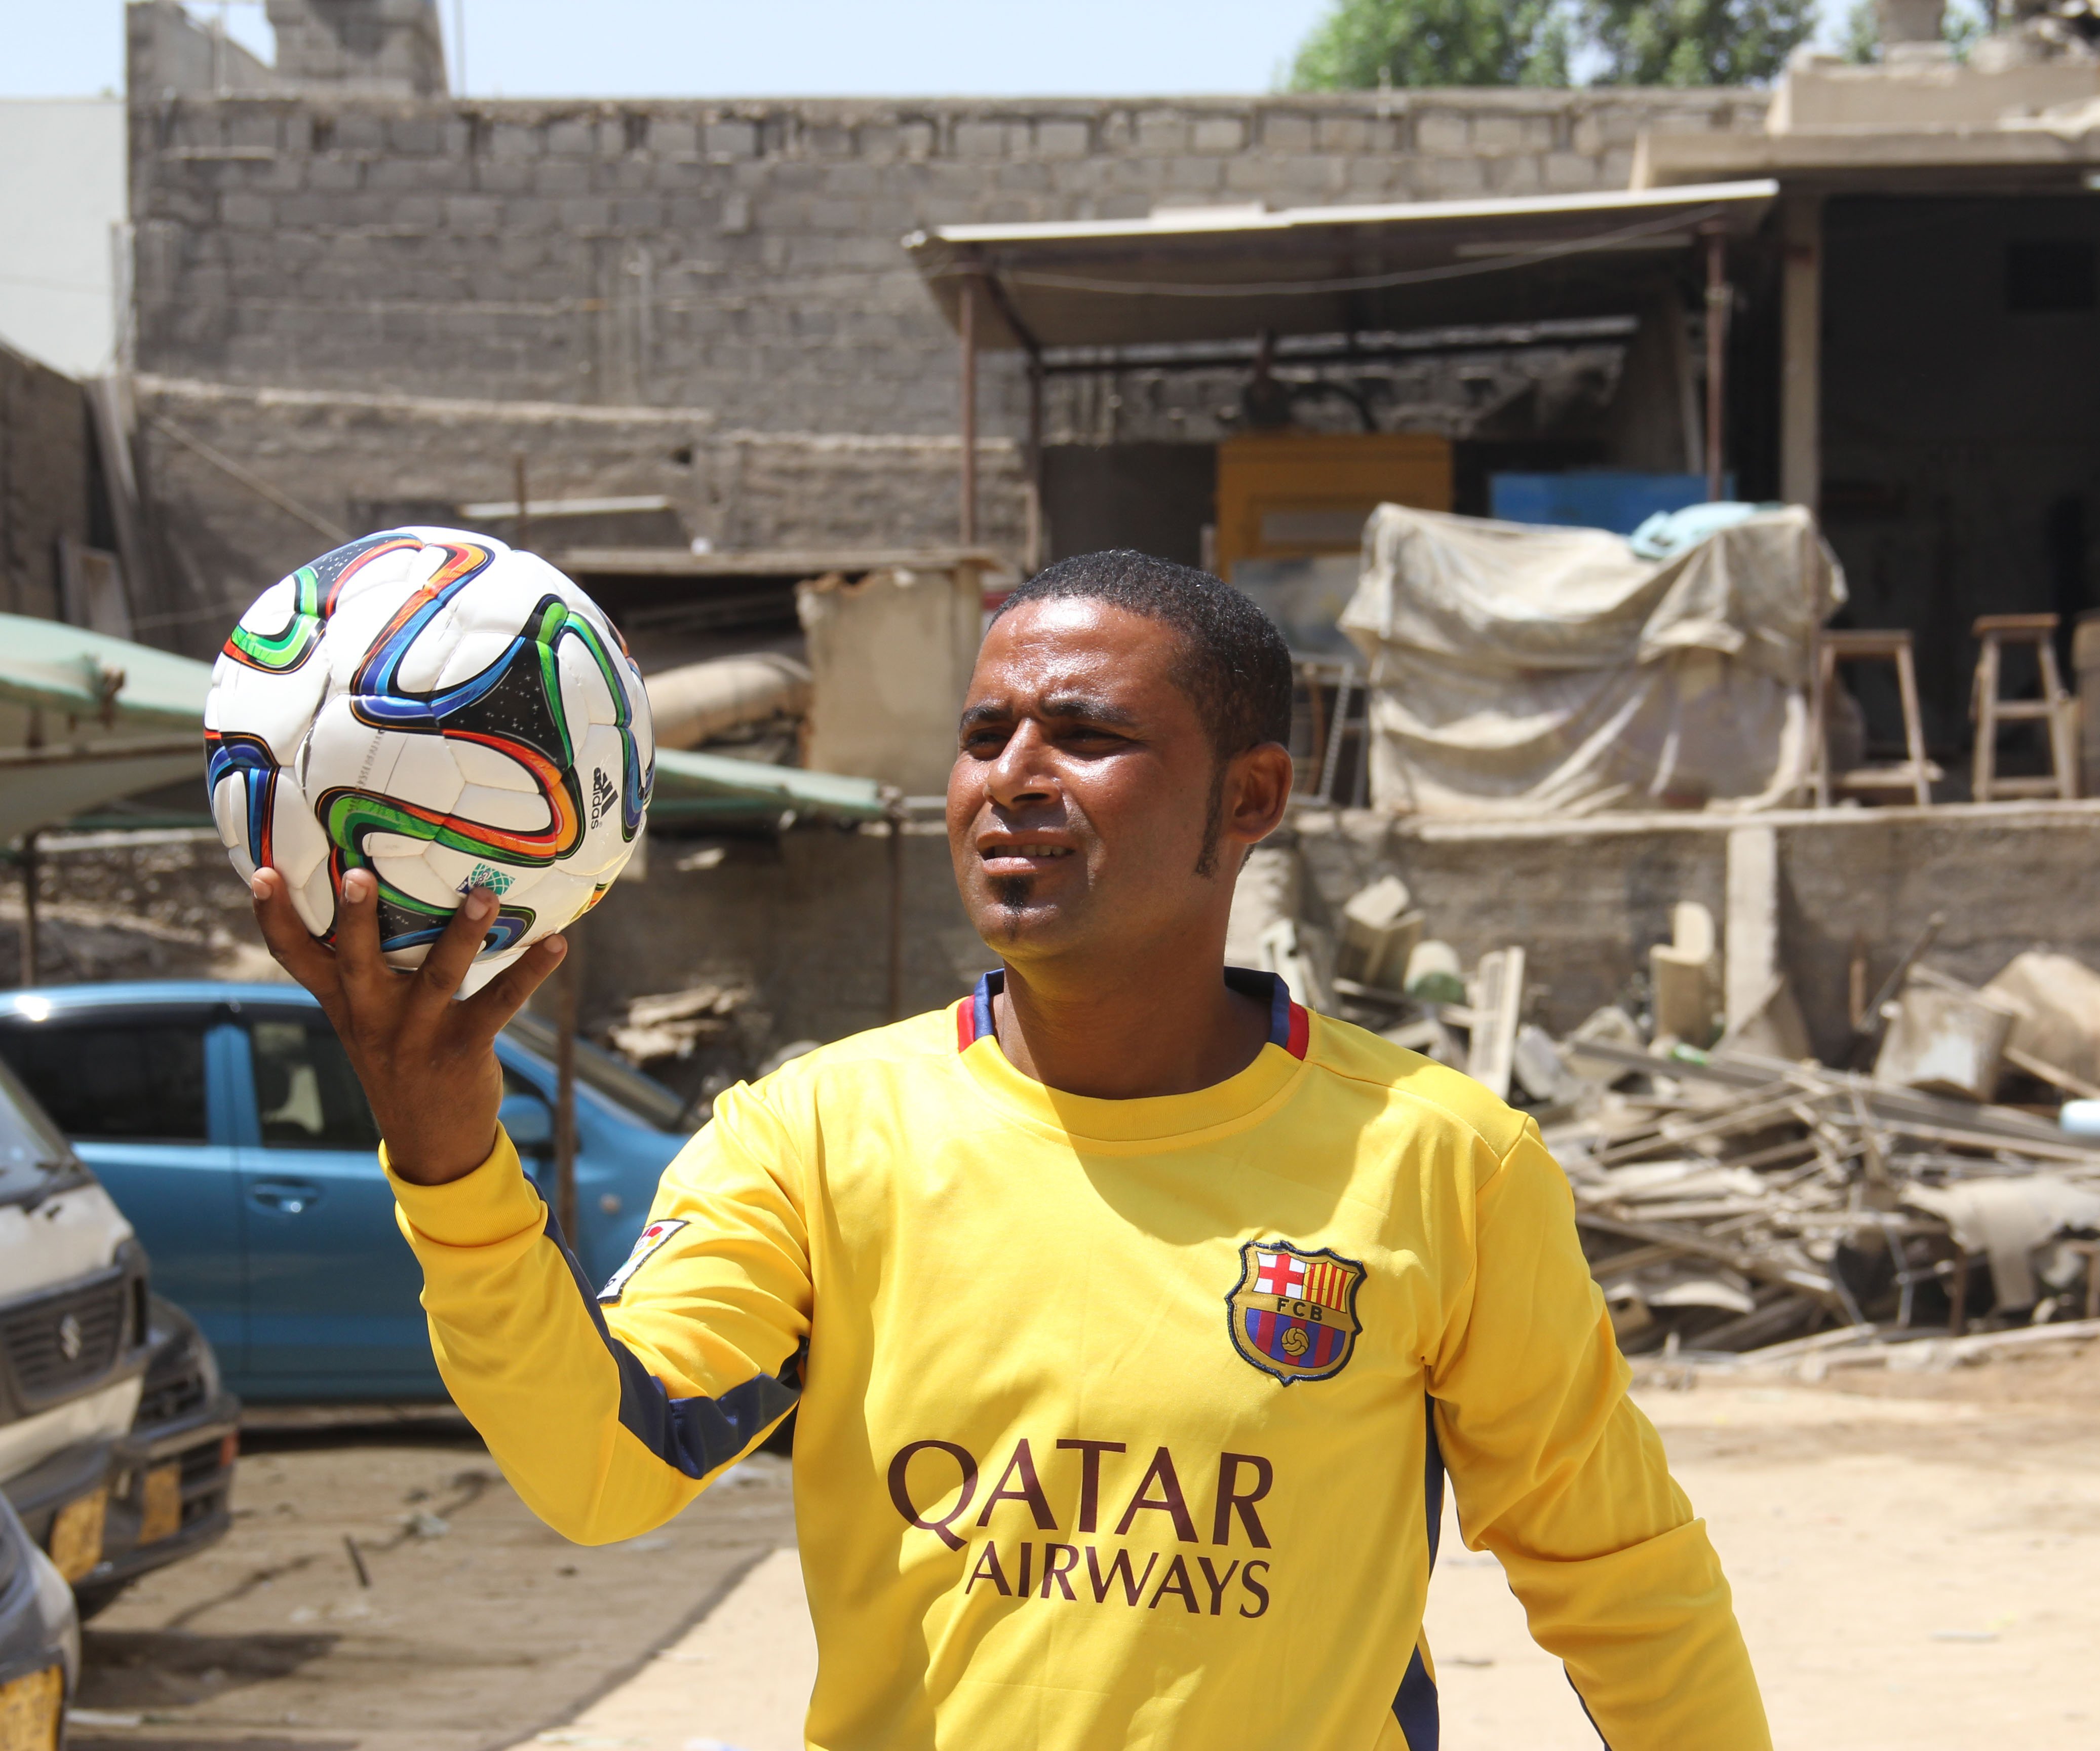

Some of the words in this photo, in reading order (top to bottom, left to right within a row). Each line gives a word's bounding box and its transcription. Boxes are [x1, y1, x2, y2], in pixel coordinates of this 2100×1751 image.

[591, 767, 603, 829] adidas
[1276, 1298, 1323, 1321] FCB
[887, 1438, 1273, 1552] QATAR
[965, 1540, 1270, 1618] AIRWAYS
